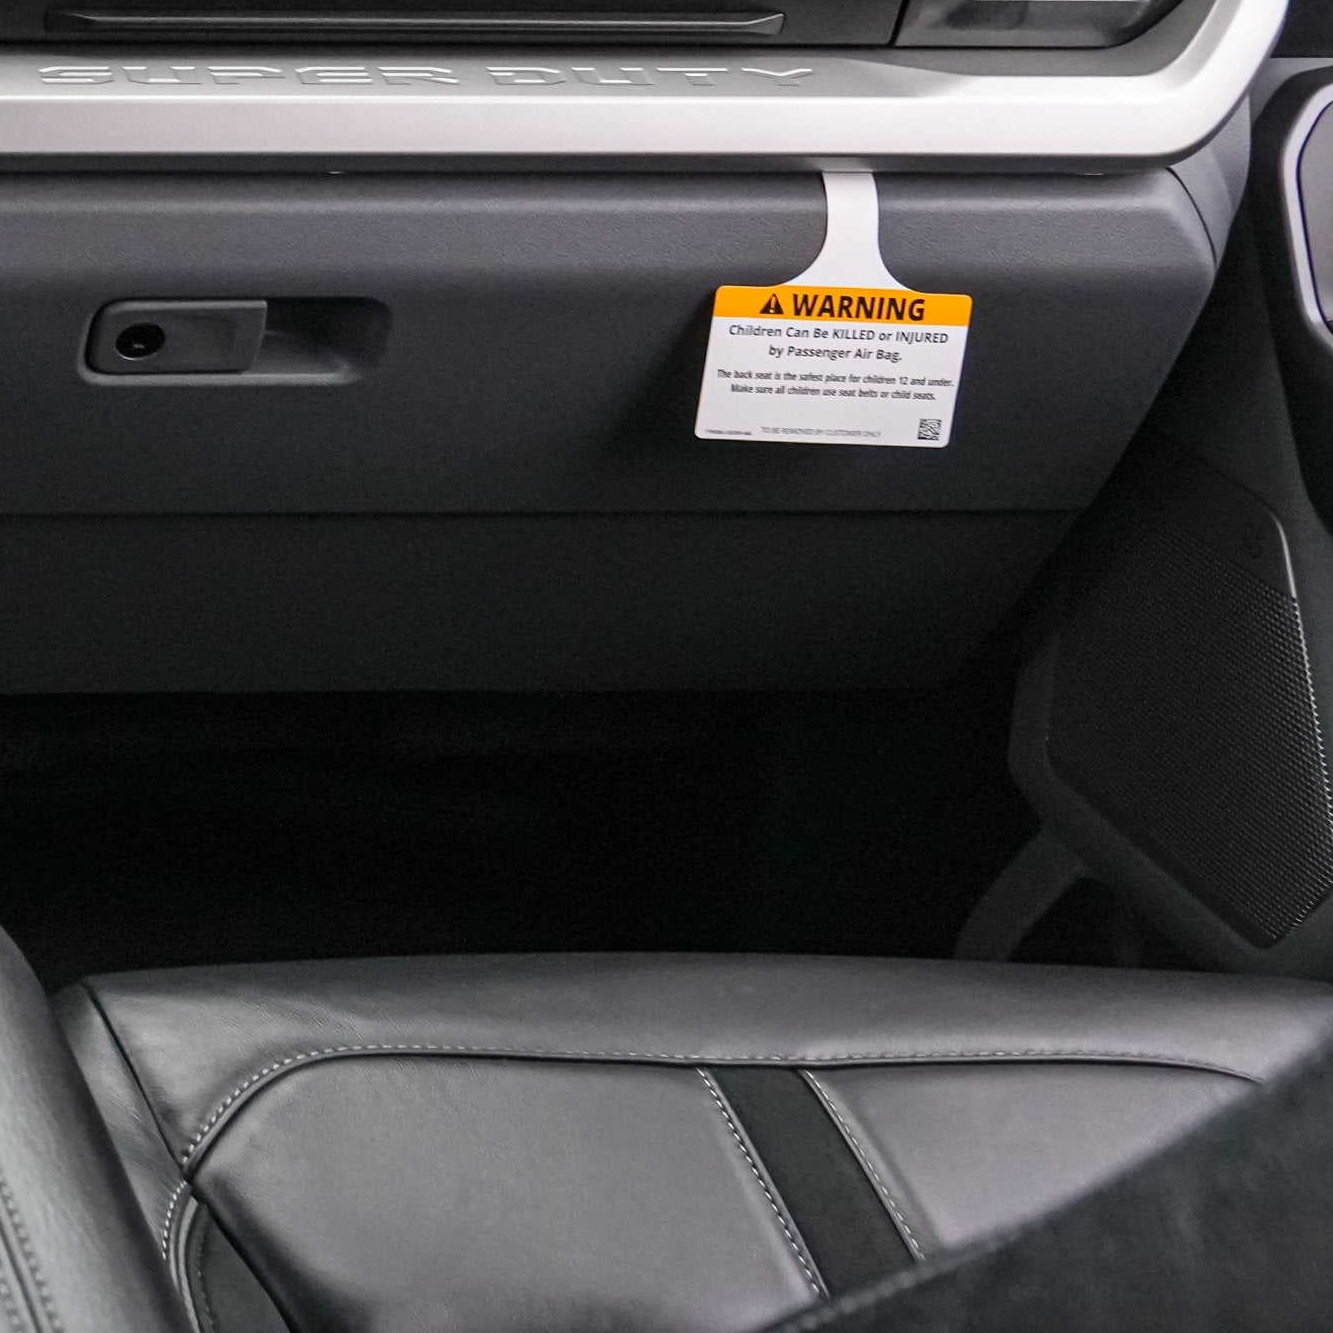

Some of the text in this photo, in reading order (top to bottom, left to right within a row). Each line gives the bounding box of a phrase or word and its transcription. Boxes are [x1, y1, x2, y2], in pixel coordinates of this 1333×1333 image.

[37, 66, 815, 85] SUPER DUTY
[792, 293, 926, 322] WARNING
[729, 325, 949, 344] Children Can Be KILLED or INJURED
[768, 345, 902, 364] by Passenger Air Bag.
[716, 369, 732, 379] The
[734, 370, 753, 380] back
[754, 372, 772, 380] seat
[784, 371, 798, 381] the
[799, 372, 823, 382] safest
[825, 373, 847, 384] place
[848, 373, 861, 383] for
[862, 374, 896, 385] children
[910, 376, 926, 386] and
[928, 377, 955, 387] under.
[730, 384, 754, 394] Make
[754, 386, 773, 394] sure
[775, 385, 785, 395] all
[787, 386, 821, 396] children
[838, 388, 857, 397] seat
[858, 389, 878, 398] belts
[891, 390, 911, 399] child
[913, 391, 937, 401] seats.
